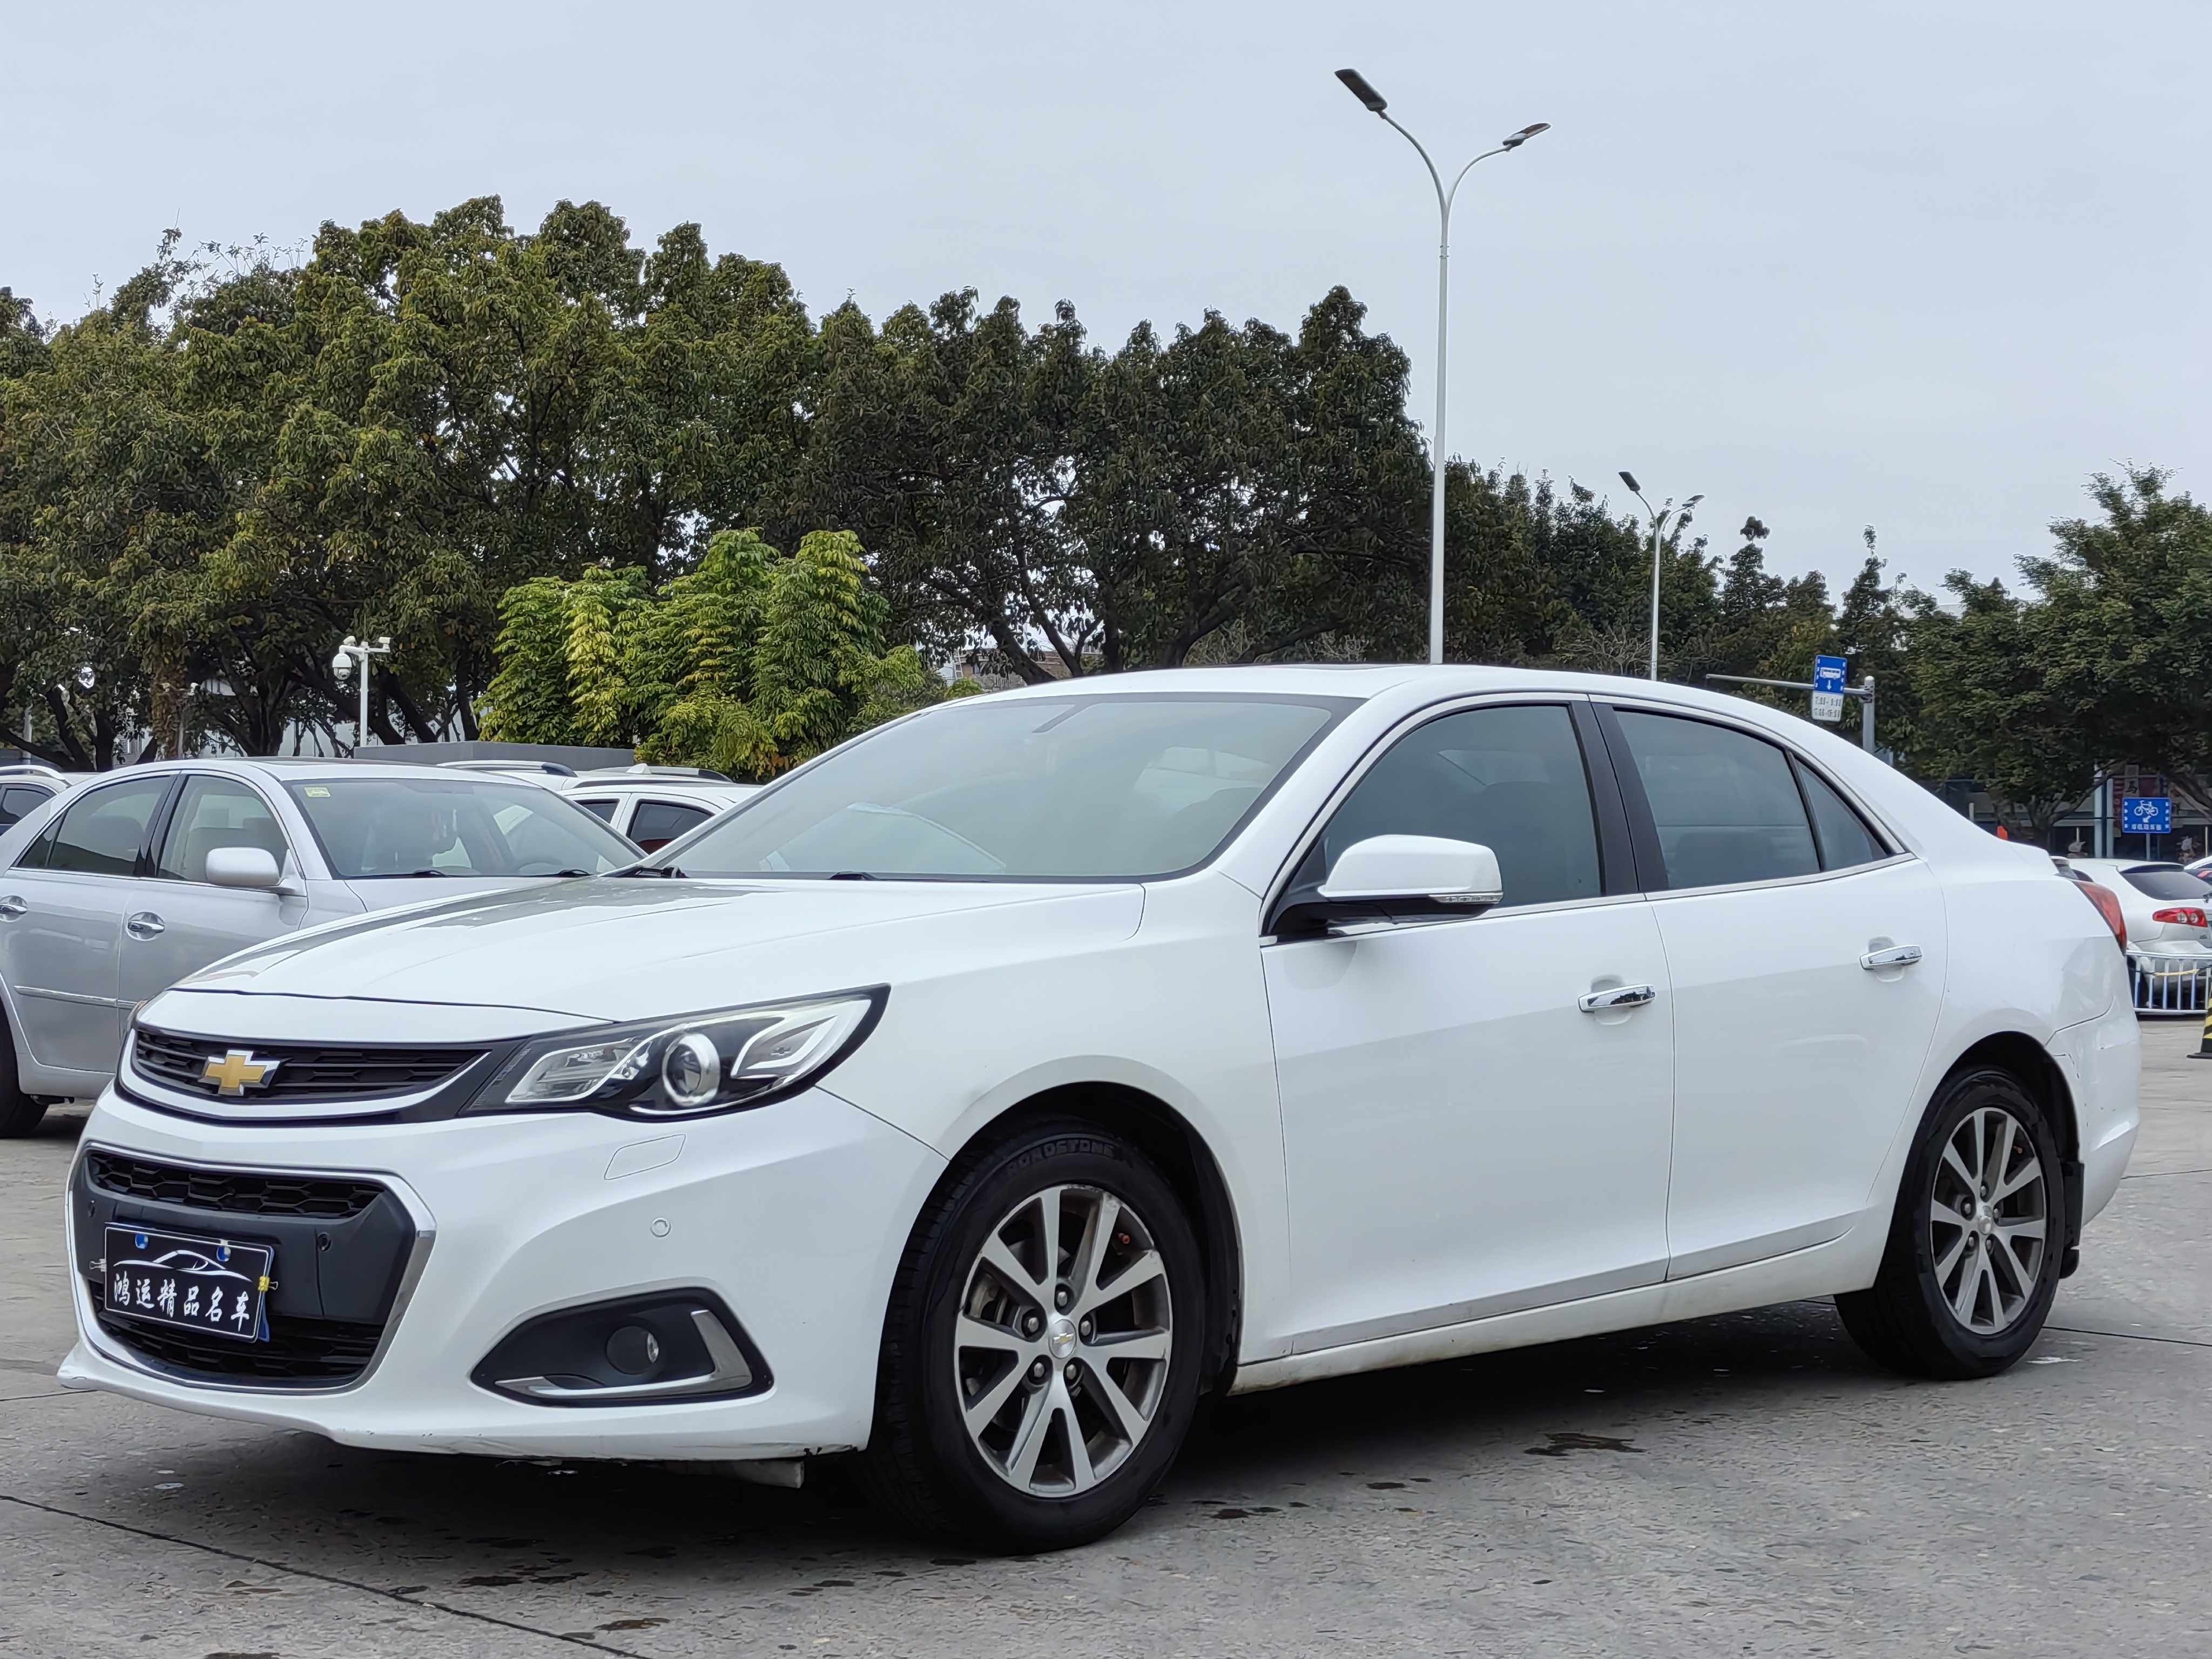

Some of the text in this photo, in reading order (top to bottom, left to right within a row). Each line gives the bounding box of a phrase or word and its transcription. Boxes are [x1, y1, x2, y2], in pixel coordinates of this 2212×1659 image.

[113, 1270, 250, 1332] 鸿运精品名车
